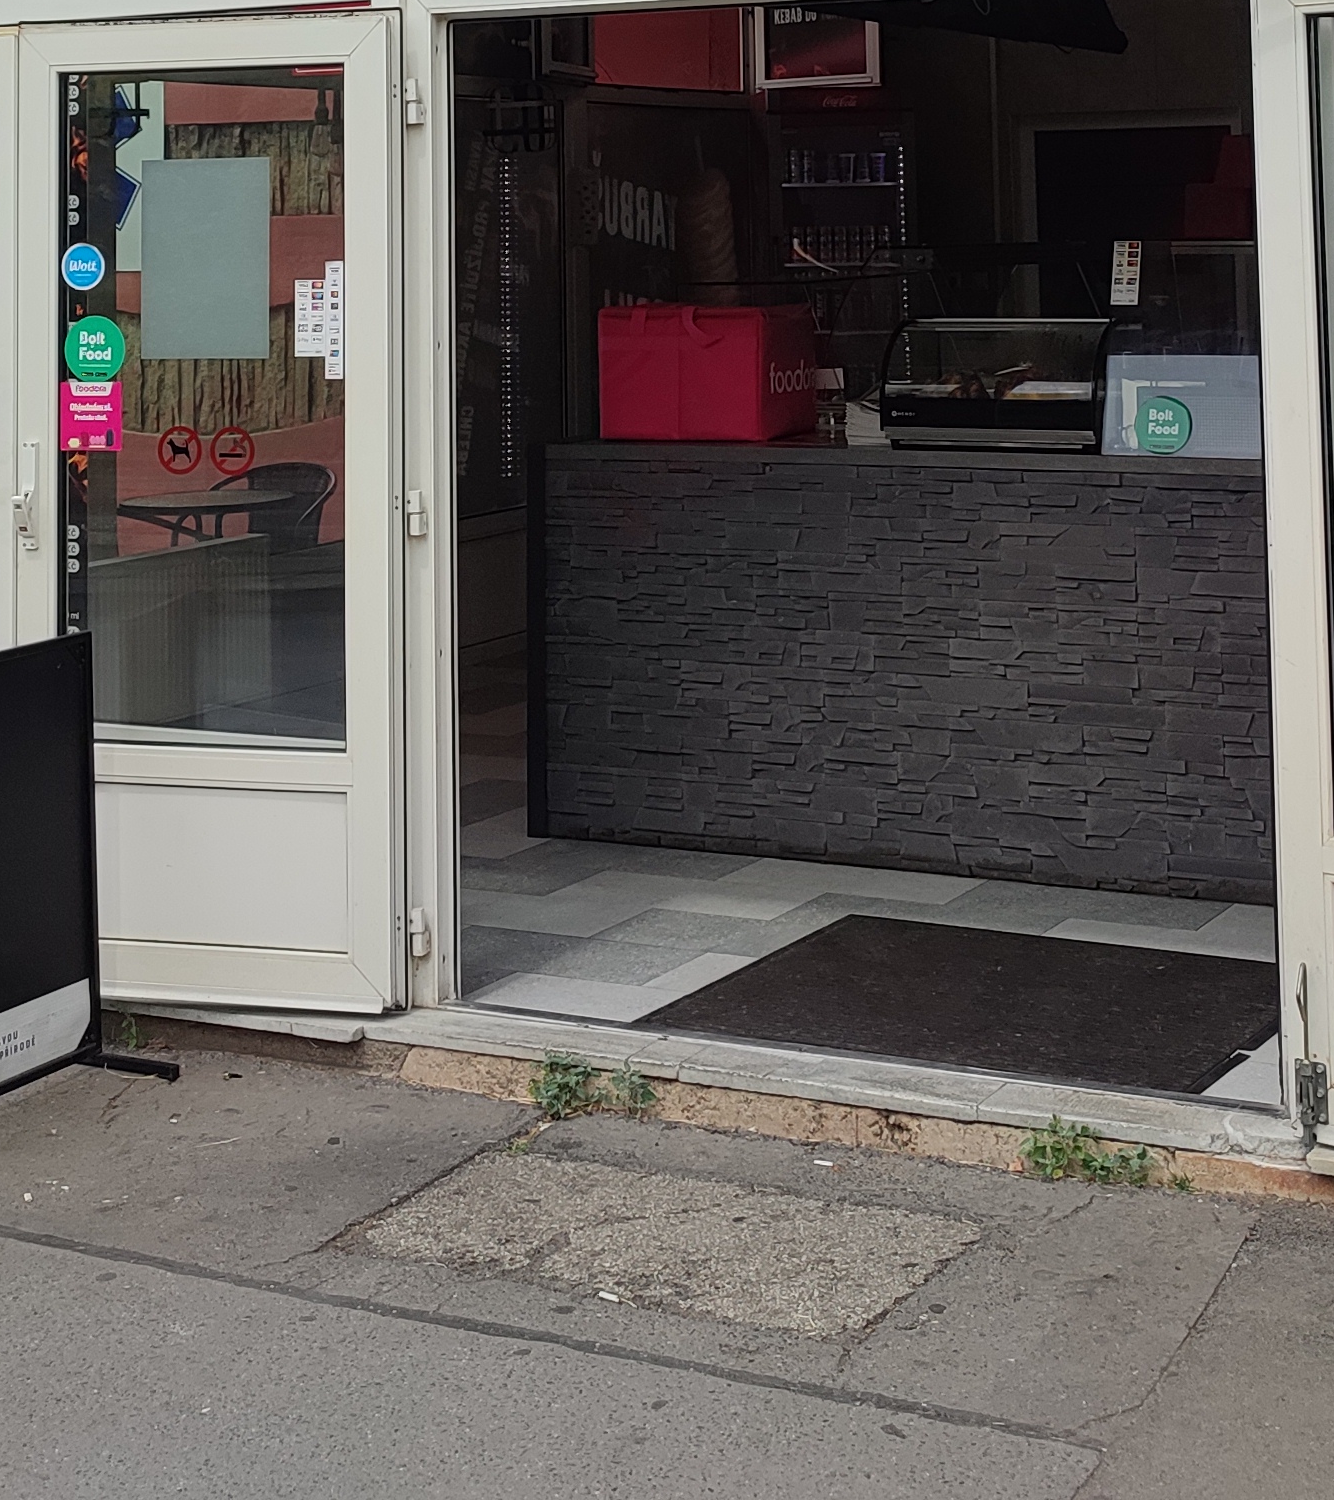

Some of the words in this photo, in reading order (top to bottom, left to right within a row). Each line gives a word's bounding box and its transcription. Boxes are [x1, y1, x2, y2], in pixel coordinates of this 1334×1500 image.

[774, 7, 802, 25] KEBAB
[79, 331, 105, 347] Bolt
[79, 347, 111, 362] Food
[1148, 408, 1174, 423] Bolt
[1148, 422, 1179, 435] Food
